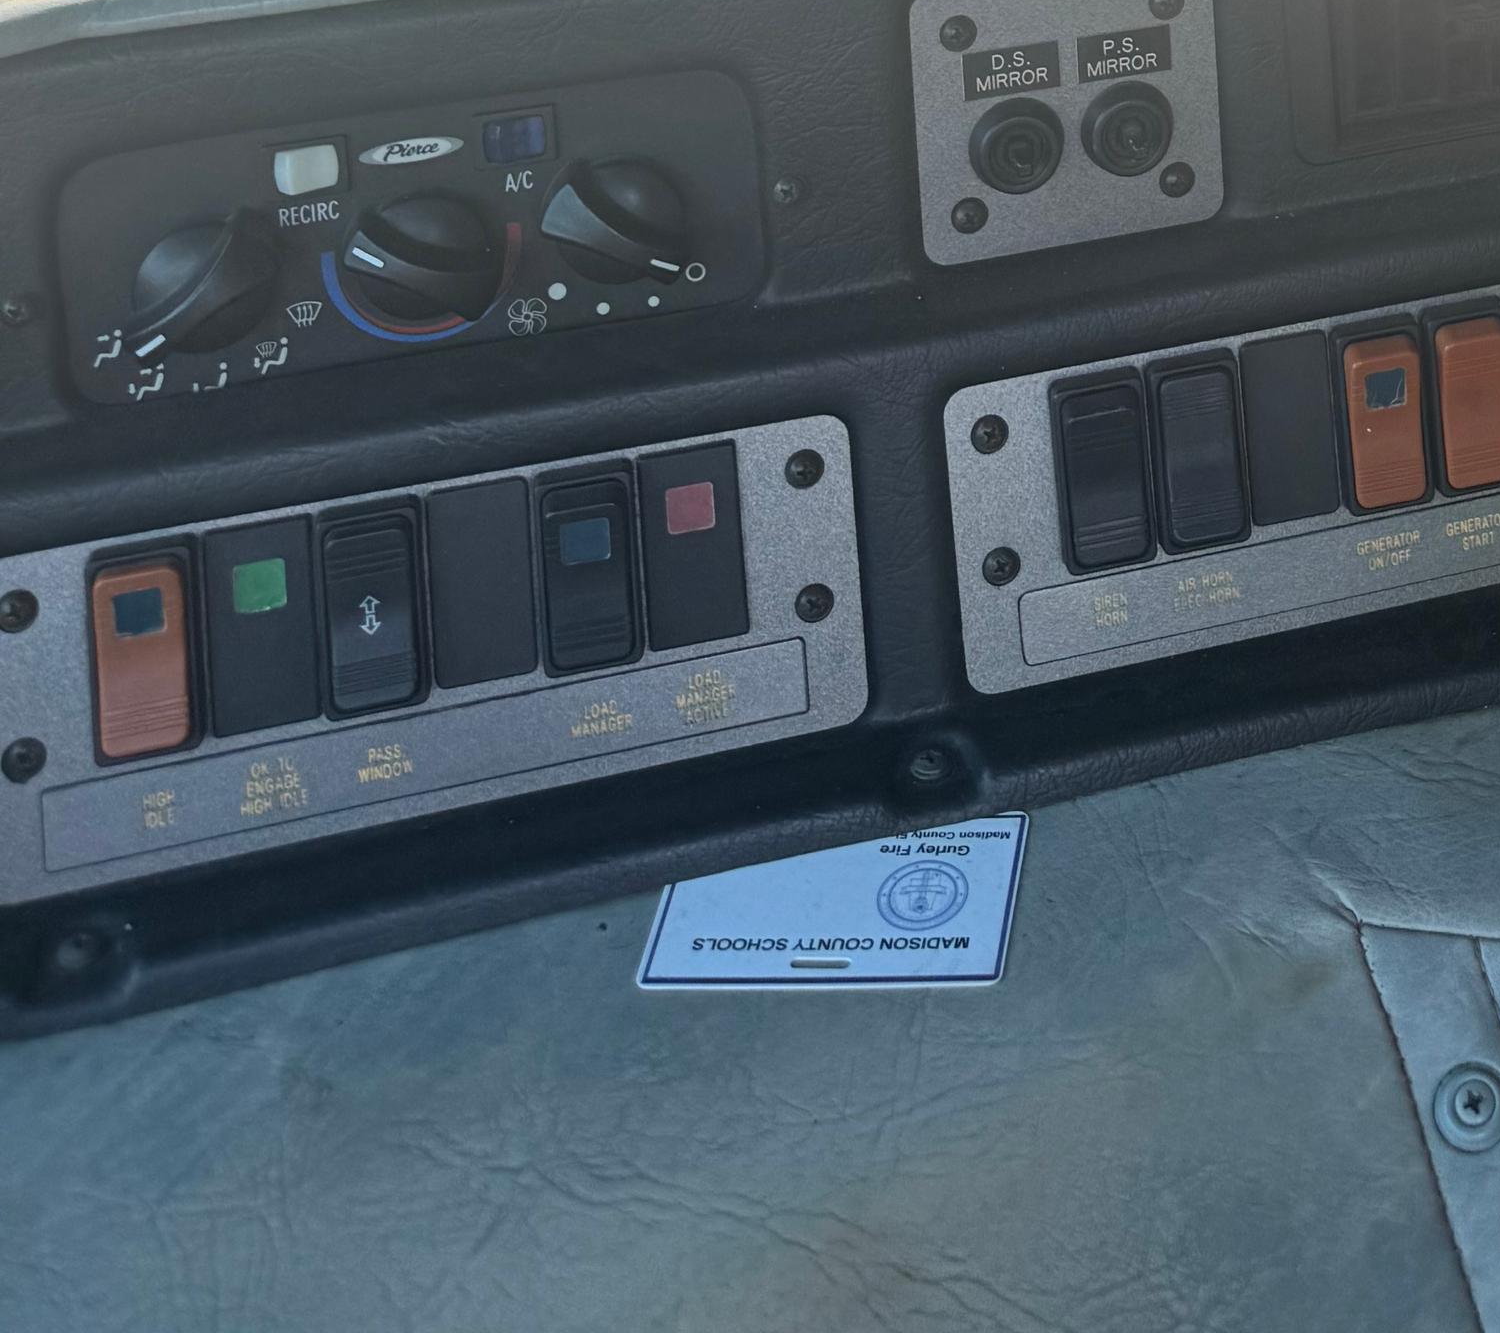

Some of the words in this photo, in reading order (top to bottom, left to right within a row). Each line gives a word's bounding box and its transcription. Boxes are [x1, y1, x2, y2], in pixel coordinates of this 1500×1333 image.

[1102, 37, 1140, 55] P.S.
[992, 51, 1031, 70] D.S.
[1087, 53, 1157, 78] MIRROR
[976, 68, 1048, 93] MIRROR
[383, 142, 440, 162] Pierce
[504, 170, 534, 193] A/C
[279, 200, 340, 228] RECIRC
[1356, 530, 1421, 556] GENERATOR
[1462, 531, 1495, 551] START
[1368, 549, 1411, 571] ON/OFF
[1178, 577, 1196, 593] AIR
[1201, 571, 1233, 587] HORN
[1094, 593, 1128, 612] SIREN
[1208, 586, 1240, 604] HORN
[1096, 610, 1128, 628] HORN
[688, 670, 721, 689] LOAD
[674, 684, 737, 709] MANAGER
[584, 700, 618, 720] LOAD
[685, 702, 730, 724] ACTIVE
[569, 713, 633, 738] MANAGER
[251, 763, 269, 779] OK
[278, 757, 294, 772] TO
[357, 759, 414, 783] WINDOW
[246, 773, 300, 798] ENGAGE
[142, 790, 175, 811] HIGH
[240, 798, 272, 817] HIGH
[278, 789, 309, 809] IDLE
[144, 807, 175, 829] IDLE
[911, 829, 955, 841] County
[959, 830, 1010, 840] Madison
[879, 843, 911, 857] Fire
[917, 842, 970, 857] Gurley
[690, 936, 789, 951] SCHOOLS
[791, 936, 875, 951] COUNTY
[879, 936, 971, 950] MADISON
